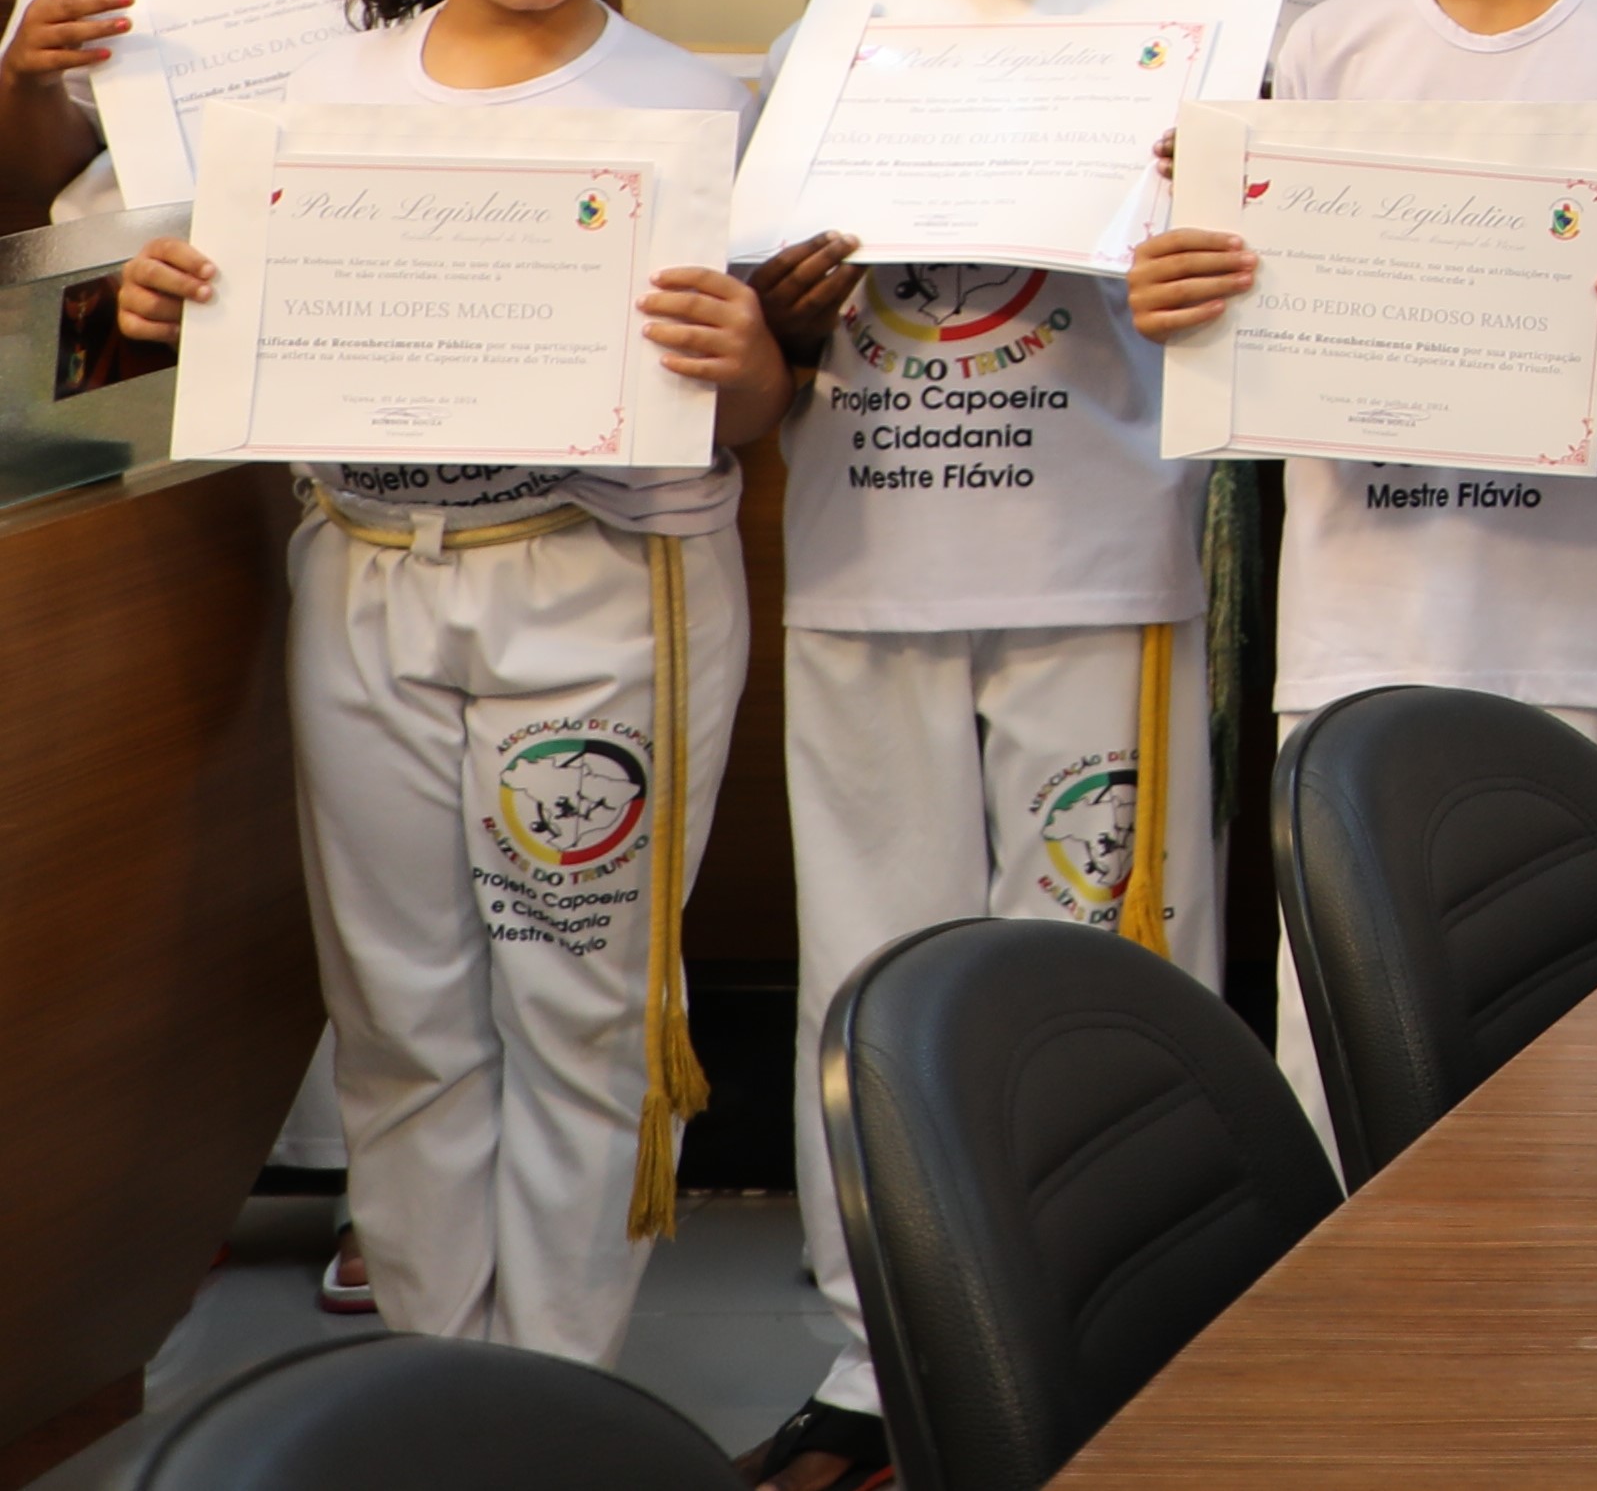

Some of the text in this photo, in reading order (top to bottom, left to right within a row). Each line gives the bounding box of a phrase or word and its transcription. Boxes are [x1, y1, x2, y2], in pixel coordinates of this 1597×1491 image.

[284, 299, 553, 320] YASMIM LOPES MACEDO
[1256, 292, 1548, 332] JOÃO PEDRO CARDOSO RAMOS
[841, 304, 1072, 381] RAÍZES DO TRIUNFO
[831, 386, 1069, 414] Projeto Capoeira
[853, 425, 1033, 449] e Cidadania
[849, 463, 1034, 489] Mestre Flávio
[1367, 480, 1542, 510] Mestre Flávio
[472, 867, 639, 912] Projeto Capoeira
[533, 869, 564, 888] DO
[488, 924, 553, 945] Mestre
